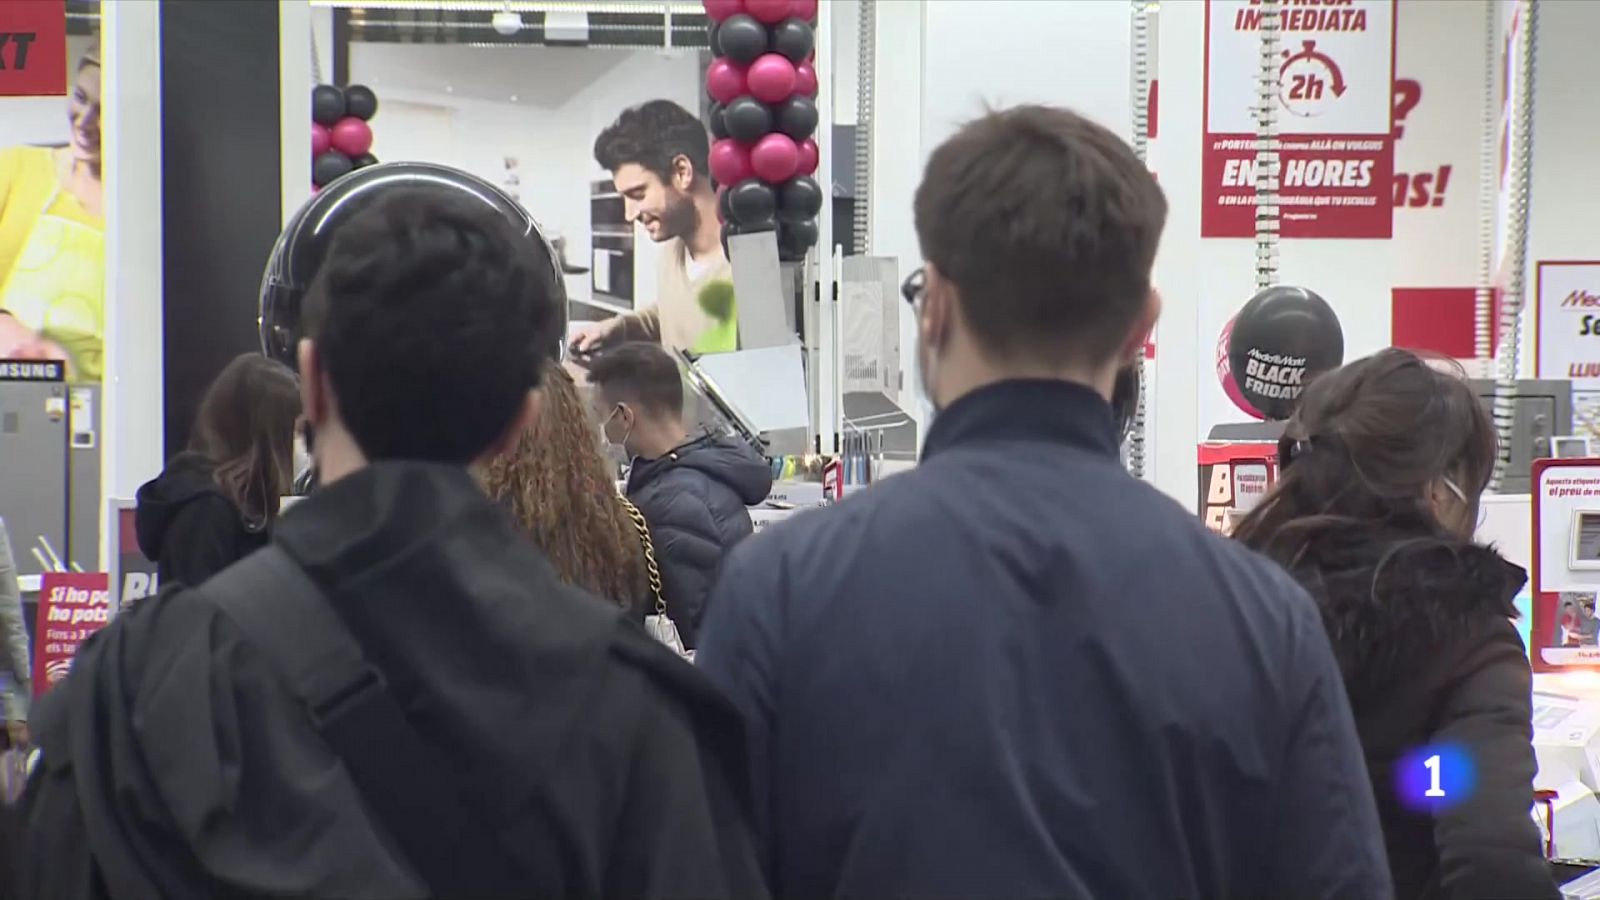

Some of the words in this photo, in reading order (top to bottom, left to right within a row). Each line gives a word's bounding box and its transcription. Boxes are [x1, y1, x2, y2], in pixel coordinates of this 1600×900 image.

[1289, 75, 1324, 100] 2h
[1221, 159, 1257, 187] EN
[1284, 159, 1375, 188] HORES
[1245, 357, 1306, 385] BLACK
[1244, 376, 1304, 400] FRIDAY
[1549, 486, 1558, 496] el
[1558, 487, 1582, 498] preu
[48, 586, 66, 602] Si
[65, 586, 90, 603] ho
[48, 605, 71, 622] ho
